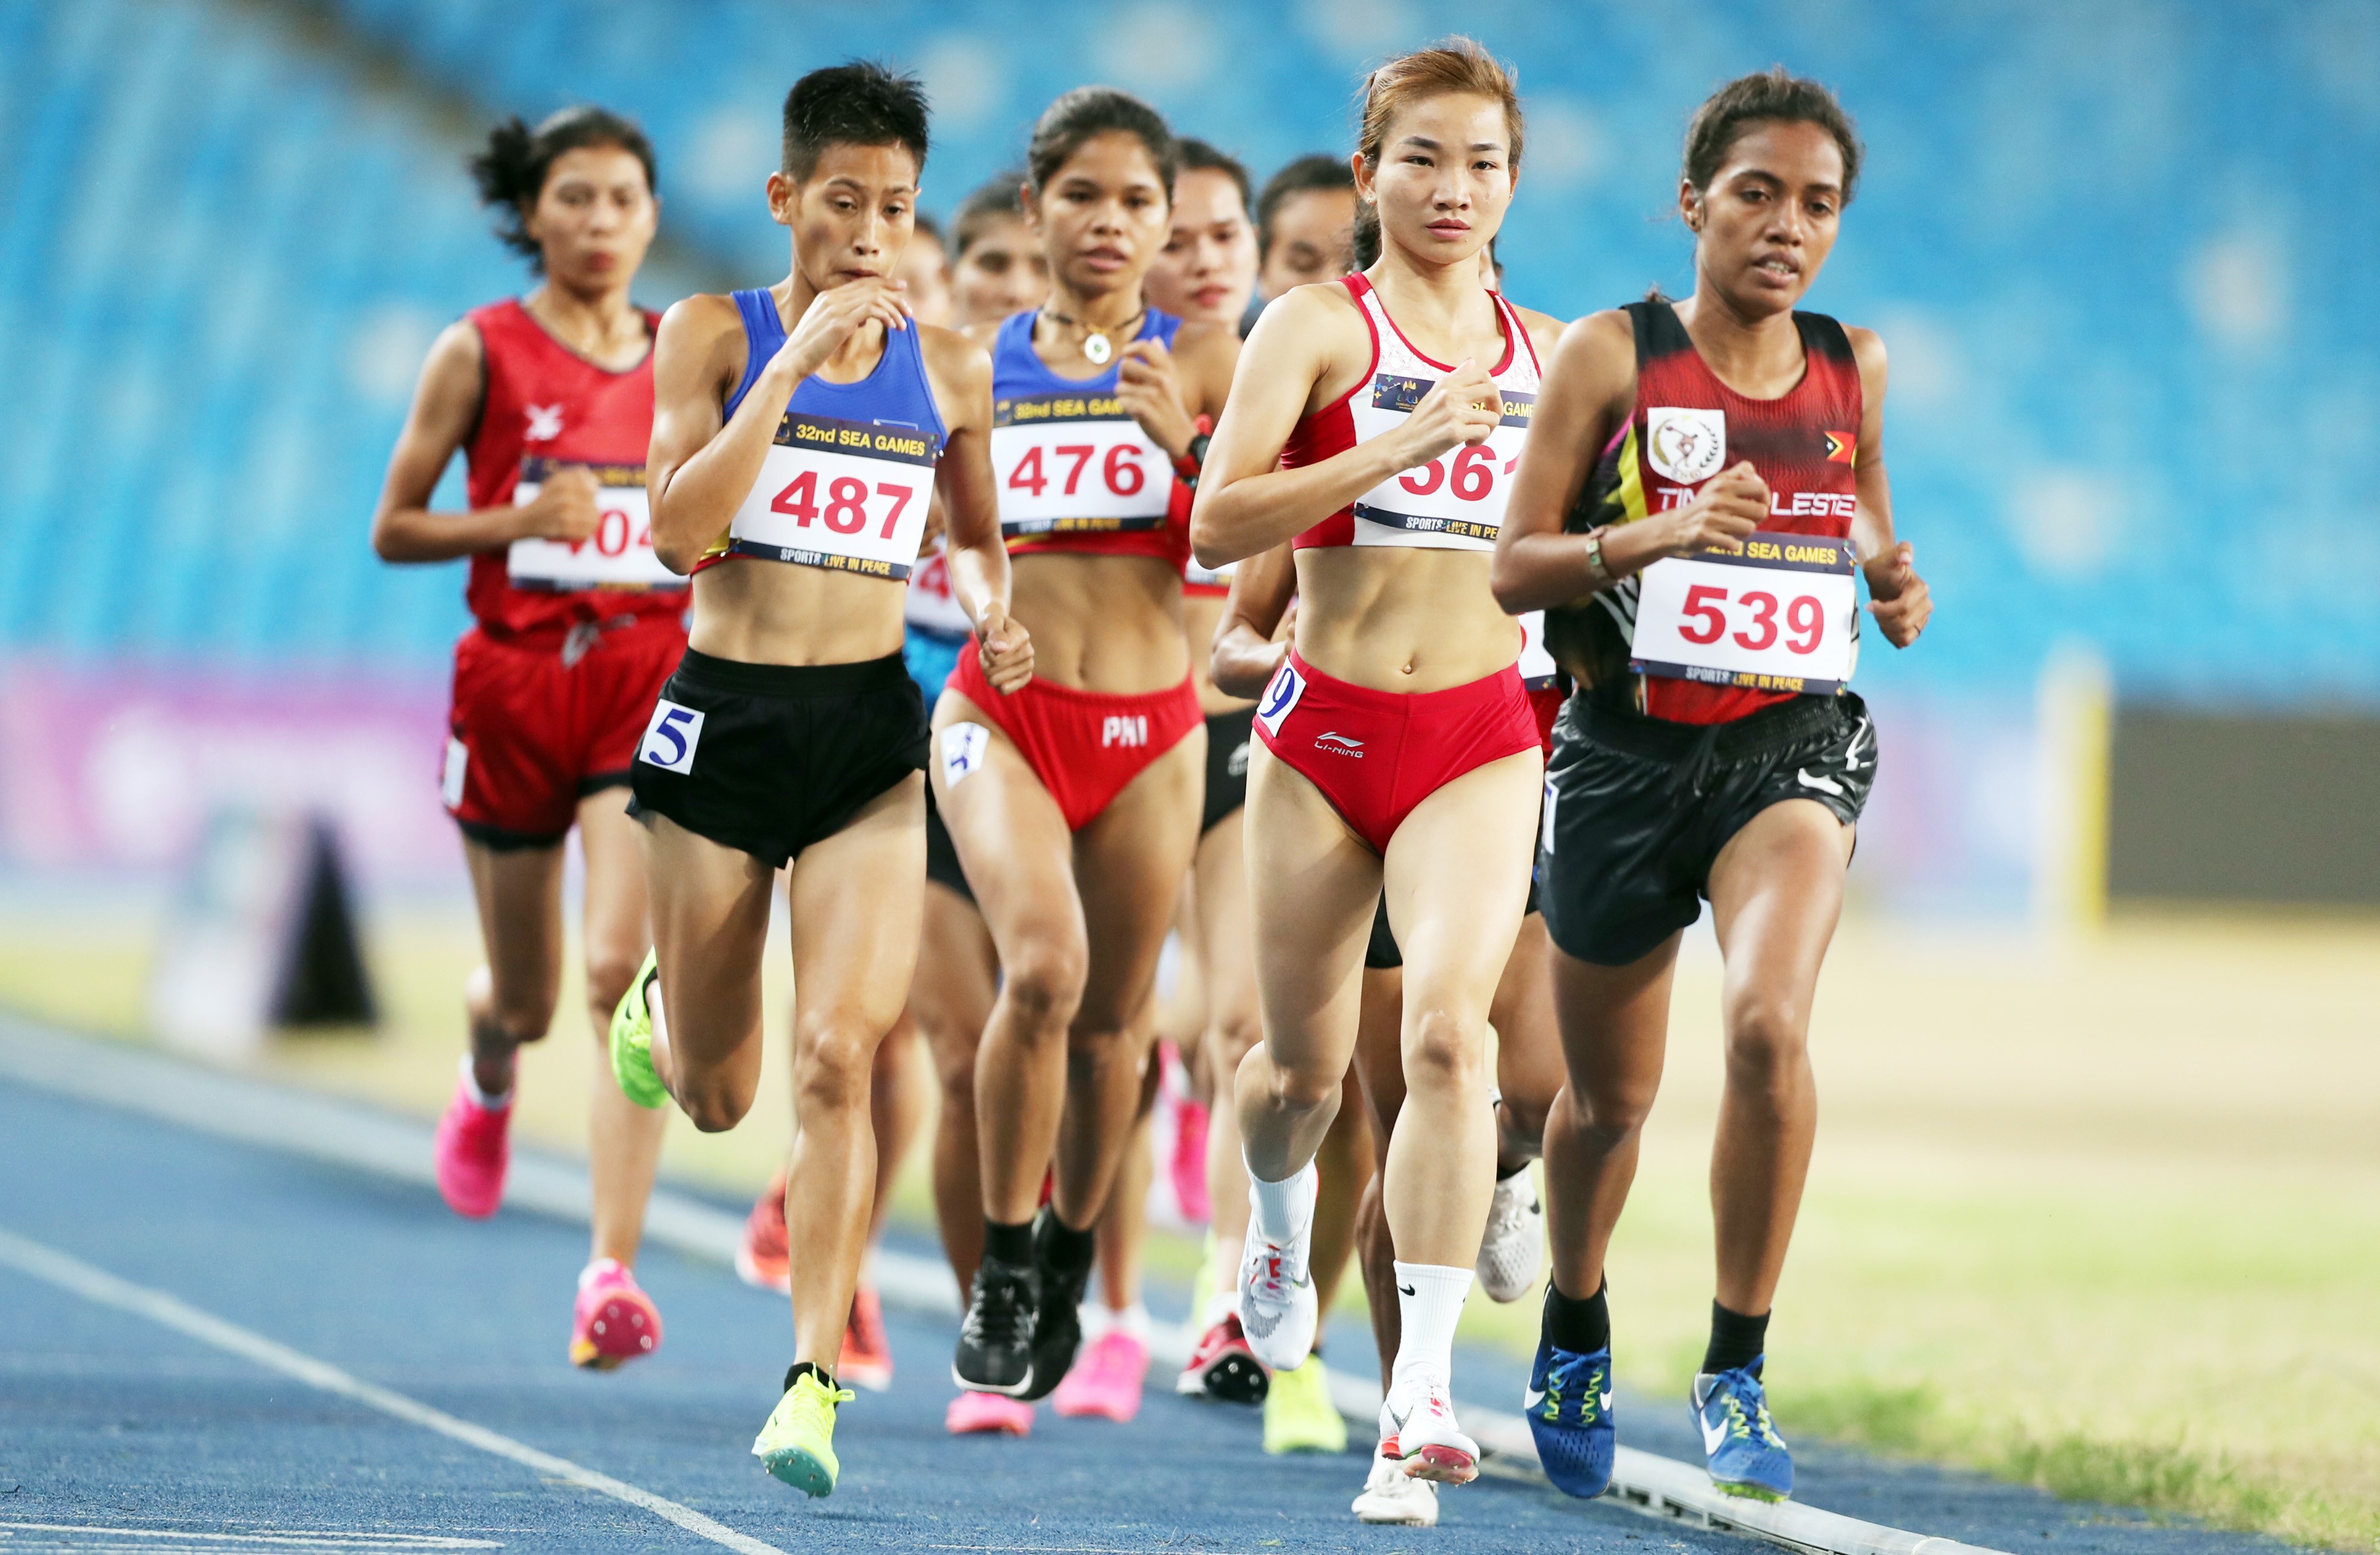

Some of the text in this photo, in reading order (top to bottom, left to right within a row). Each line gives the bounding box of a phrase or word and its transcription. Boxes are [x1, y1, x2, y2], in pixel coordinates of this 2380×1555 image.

[1053, 399, 1087, 417] SEA
[1503, 401, 1534, 417] GAME
[796, 424, 925, 456] 32nd SEA GAMES
[1008, 444, 1144, 496] 476
[1399, 444, 1523, 501] 56
[770, 471, 913, 540] 487
[1770, 492, 1856, 517] LESTE
[1406, 516, 1443, 531] SPORTS
[1445, 521, 1468, 535] LIVE
[1469, 524, 1481, 537] IN
[780, 548, 891, 575] SPORTS LIVE IN PEACE
[1747, 541, 1782, 560] SEA
[1784, 544, 1838, 565] GAMES
[1678, 584, 1824, 655] 539
[1260, 667, 1295, 718] 9
[1685, 666, 1804, 692] SPORTS LIVE IN PEACE
[649, 708, 695, 765] 5
[1314, 740, 1364, 758] LI-NING
